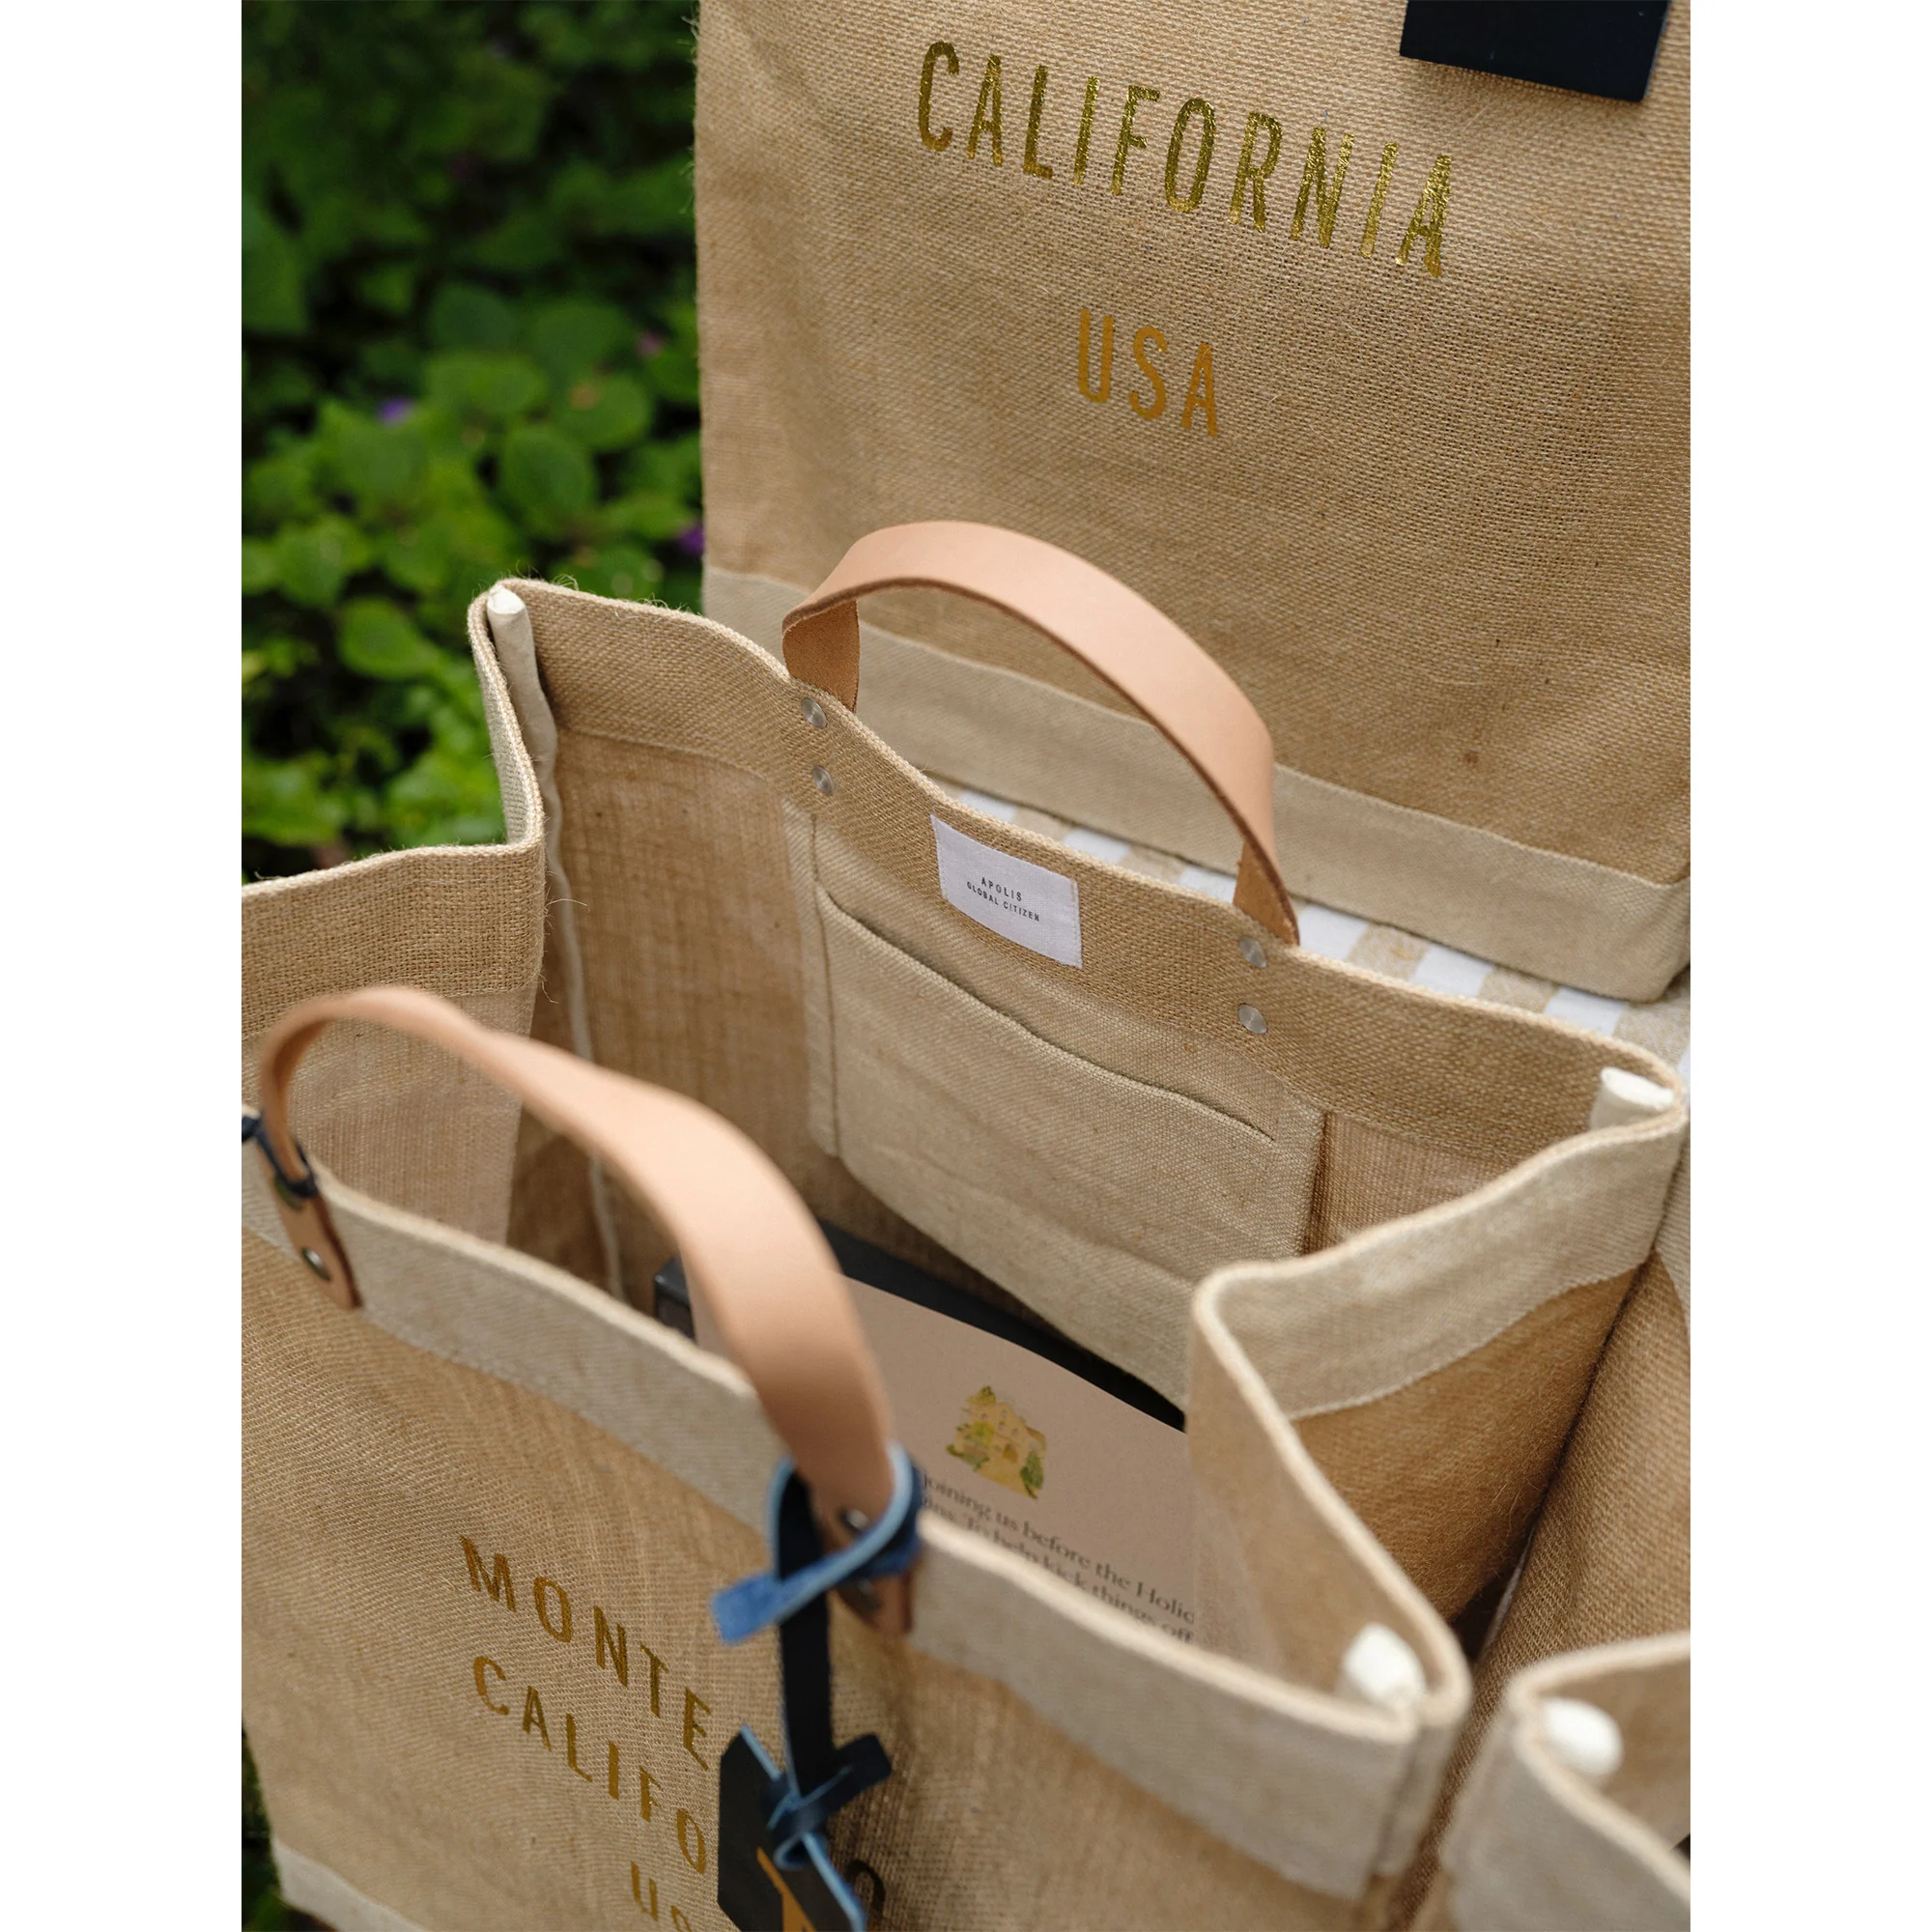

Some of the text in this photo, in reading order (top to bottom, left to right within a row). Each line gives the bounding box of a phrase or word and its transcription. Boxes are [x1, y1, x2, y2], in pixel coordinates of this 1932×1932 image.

[917, 41, 1453, 278] CALIFORNIA
[1078, 308, 1219, 438] USA
[966, 881, 1040, 923] GLOBAL CITIZEN
[980, 876, 1023, 902] APOLIS
[995, 1510, 1020, 1532] us
[1022, 1520, 1092, 1570] before
[1094, 1562, 1132, 1591] the
[460, 1533, 713, 1772] MONTE
[471, 1654, 708, 1876] CALIFO
